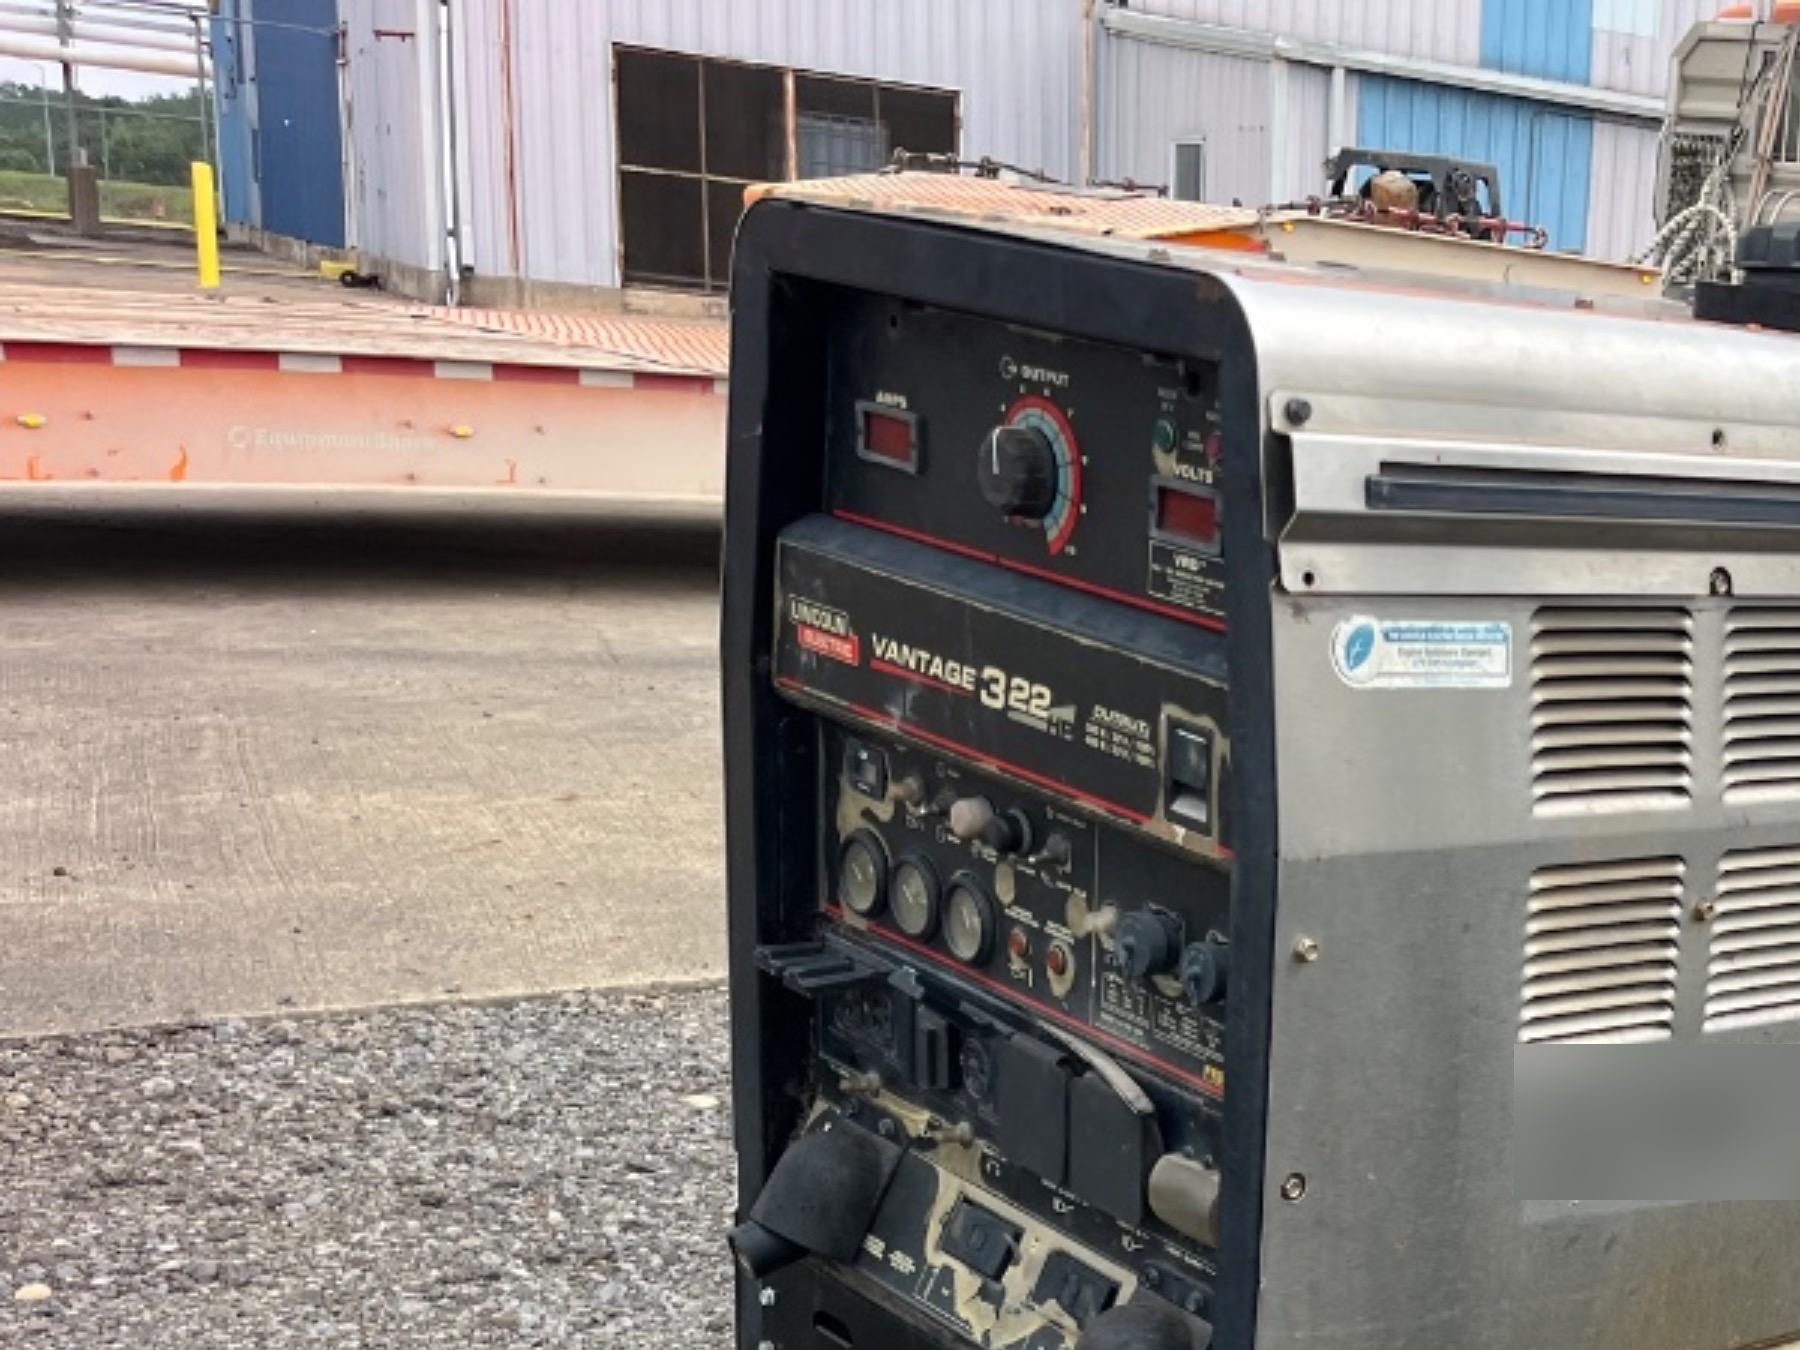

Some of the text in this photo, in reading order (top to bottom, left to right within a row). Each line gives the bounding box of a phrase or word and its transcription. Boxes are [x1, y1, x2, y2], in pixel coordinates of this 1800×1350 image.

[1173, 463, 1213, 484] VOLTS
[789, 599, 850, 637] LINCOLN
[871, 632, 1052, 720] VANTAGE 322
